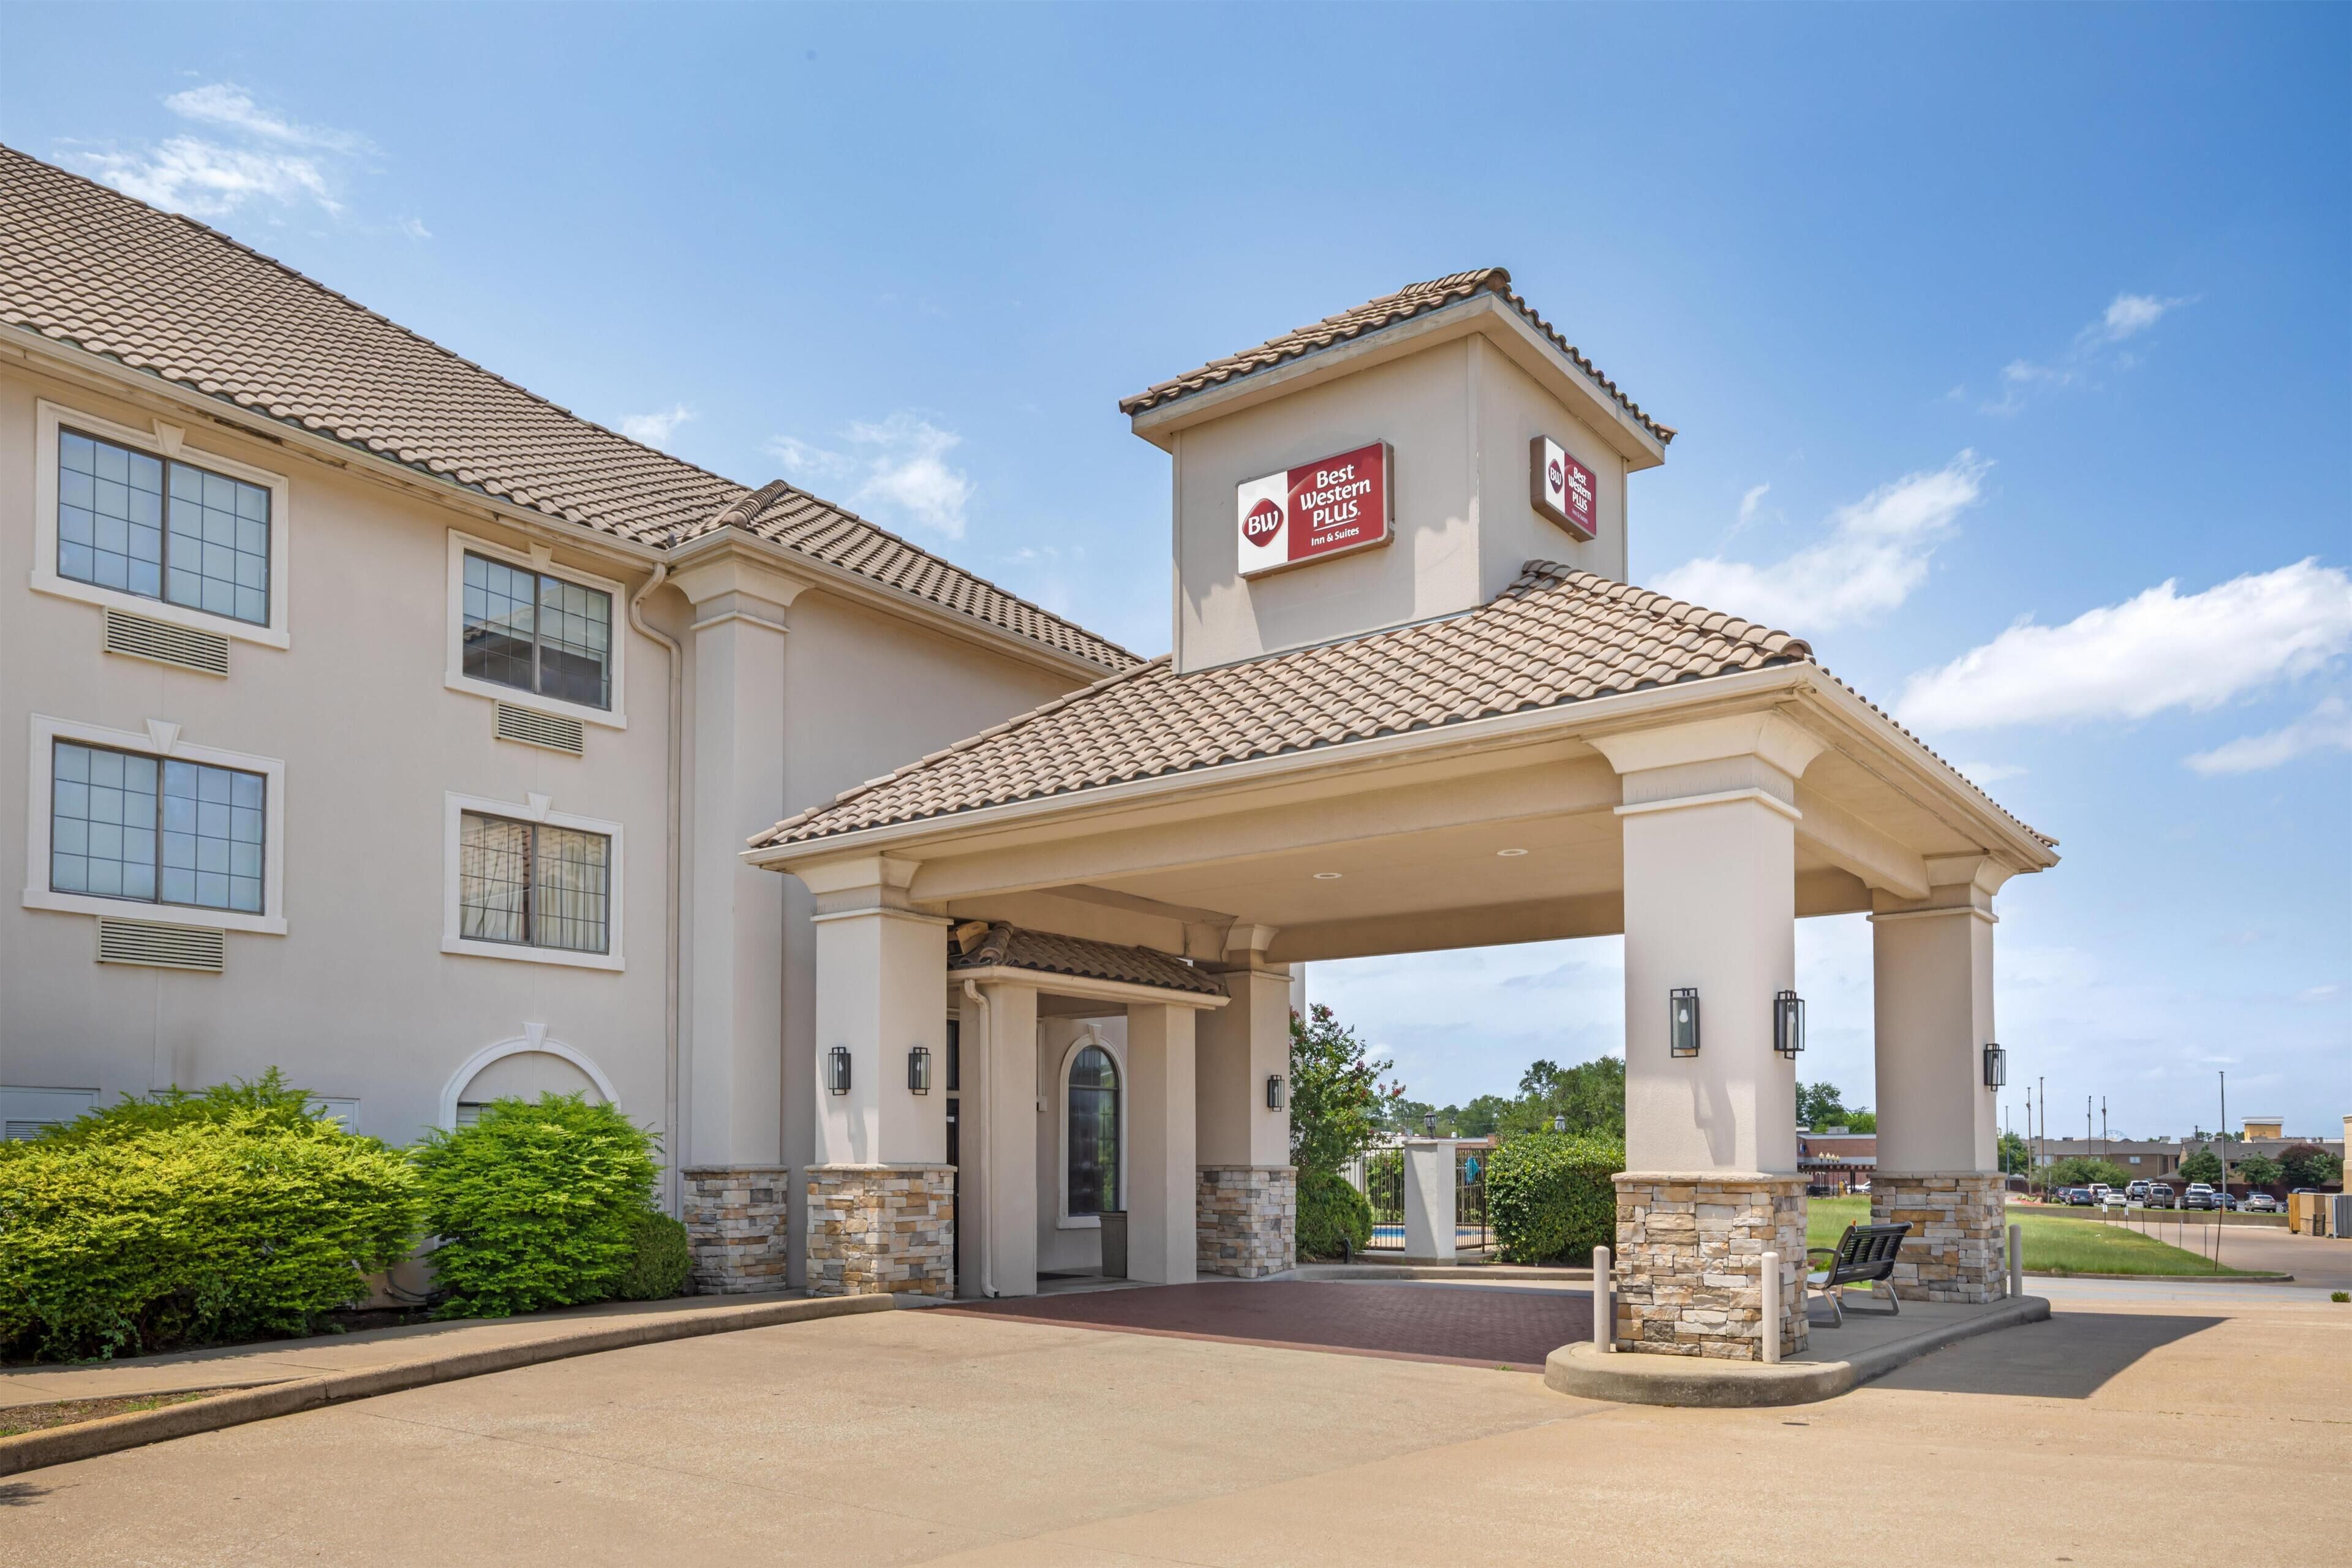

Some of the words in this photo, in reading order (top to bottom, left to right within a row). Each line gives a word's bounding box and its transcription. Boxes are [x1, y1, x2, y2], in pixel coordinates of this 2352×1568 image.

[1317, 464, 1354, 488] Best
[1550, 467, 1561, 485] BW
[1568, 474, 1591, 501] Western
[1574, 467, 1586, 486] Best
[1300, 479, 1371, 510] Western
[1572, 491, 1588, 511] PLUS
[1248, 510, 1278, 535] BW
[1313, 500, 1358, 527] PLUS
[1311, 537, 1325, 546] Inn
[1327, 532, 1333, 542] &
[1335, 527, 1359, 541] Suites
